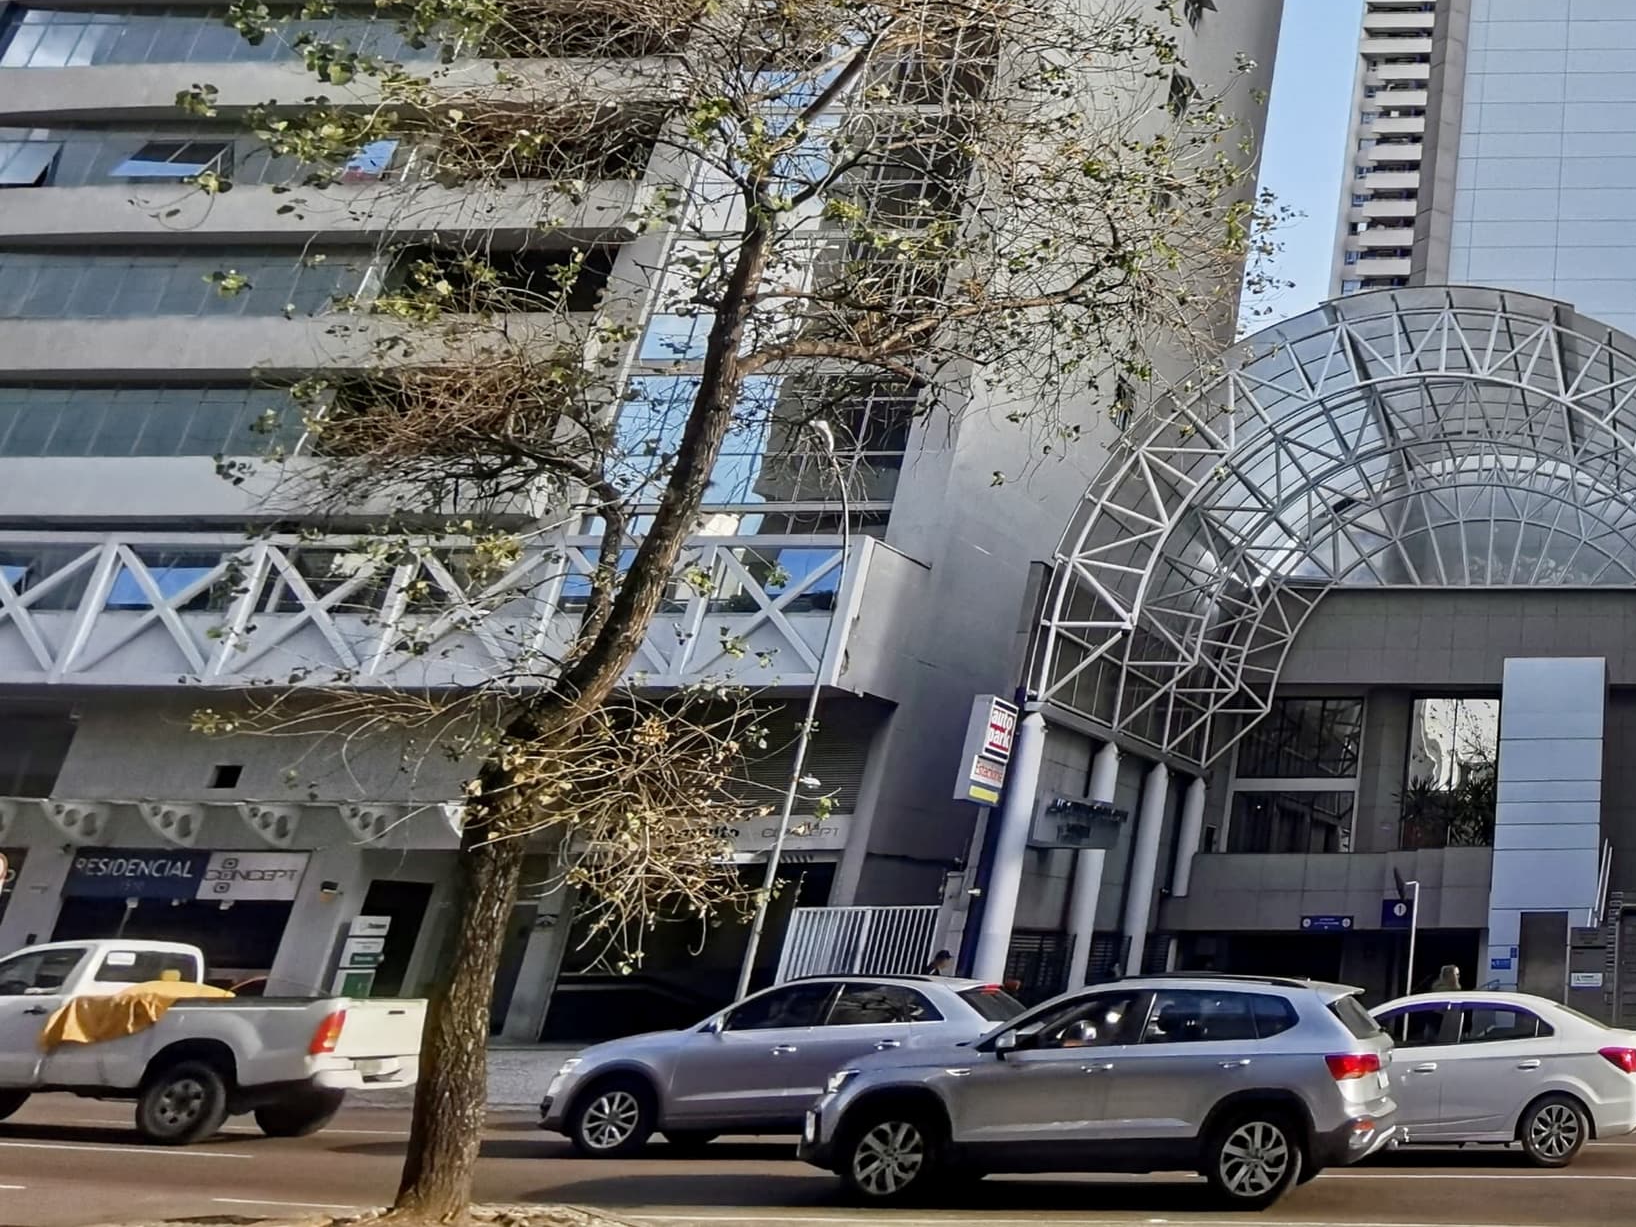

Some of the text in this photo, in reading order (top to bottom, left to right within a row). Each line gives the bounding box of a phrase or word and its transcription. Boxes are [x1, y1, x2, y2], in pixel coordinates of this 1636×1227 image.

[991, 708, 1013, 731] auto
[986, 727, 1010, 749] park
[75, 858, 193, 878] RESIDENCIAL
